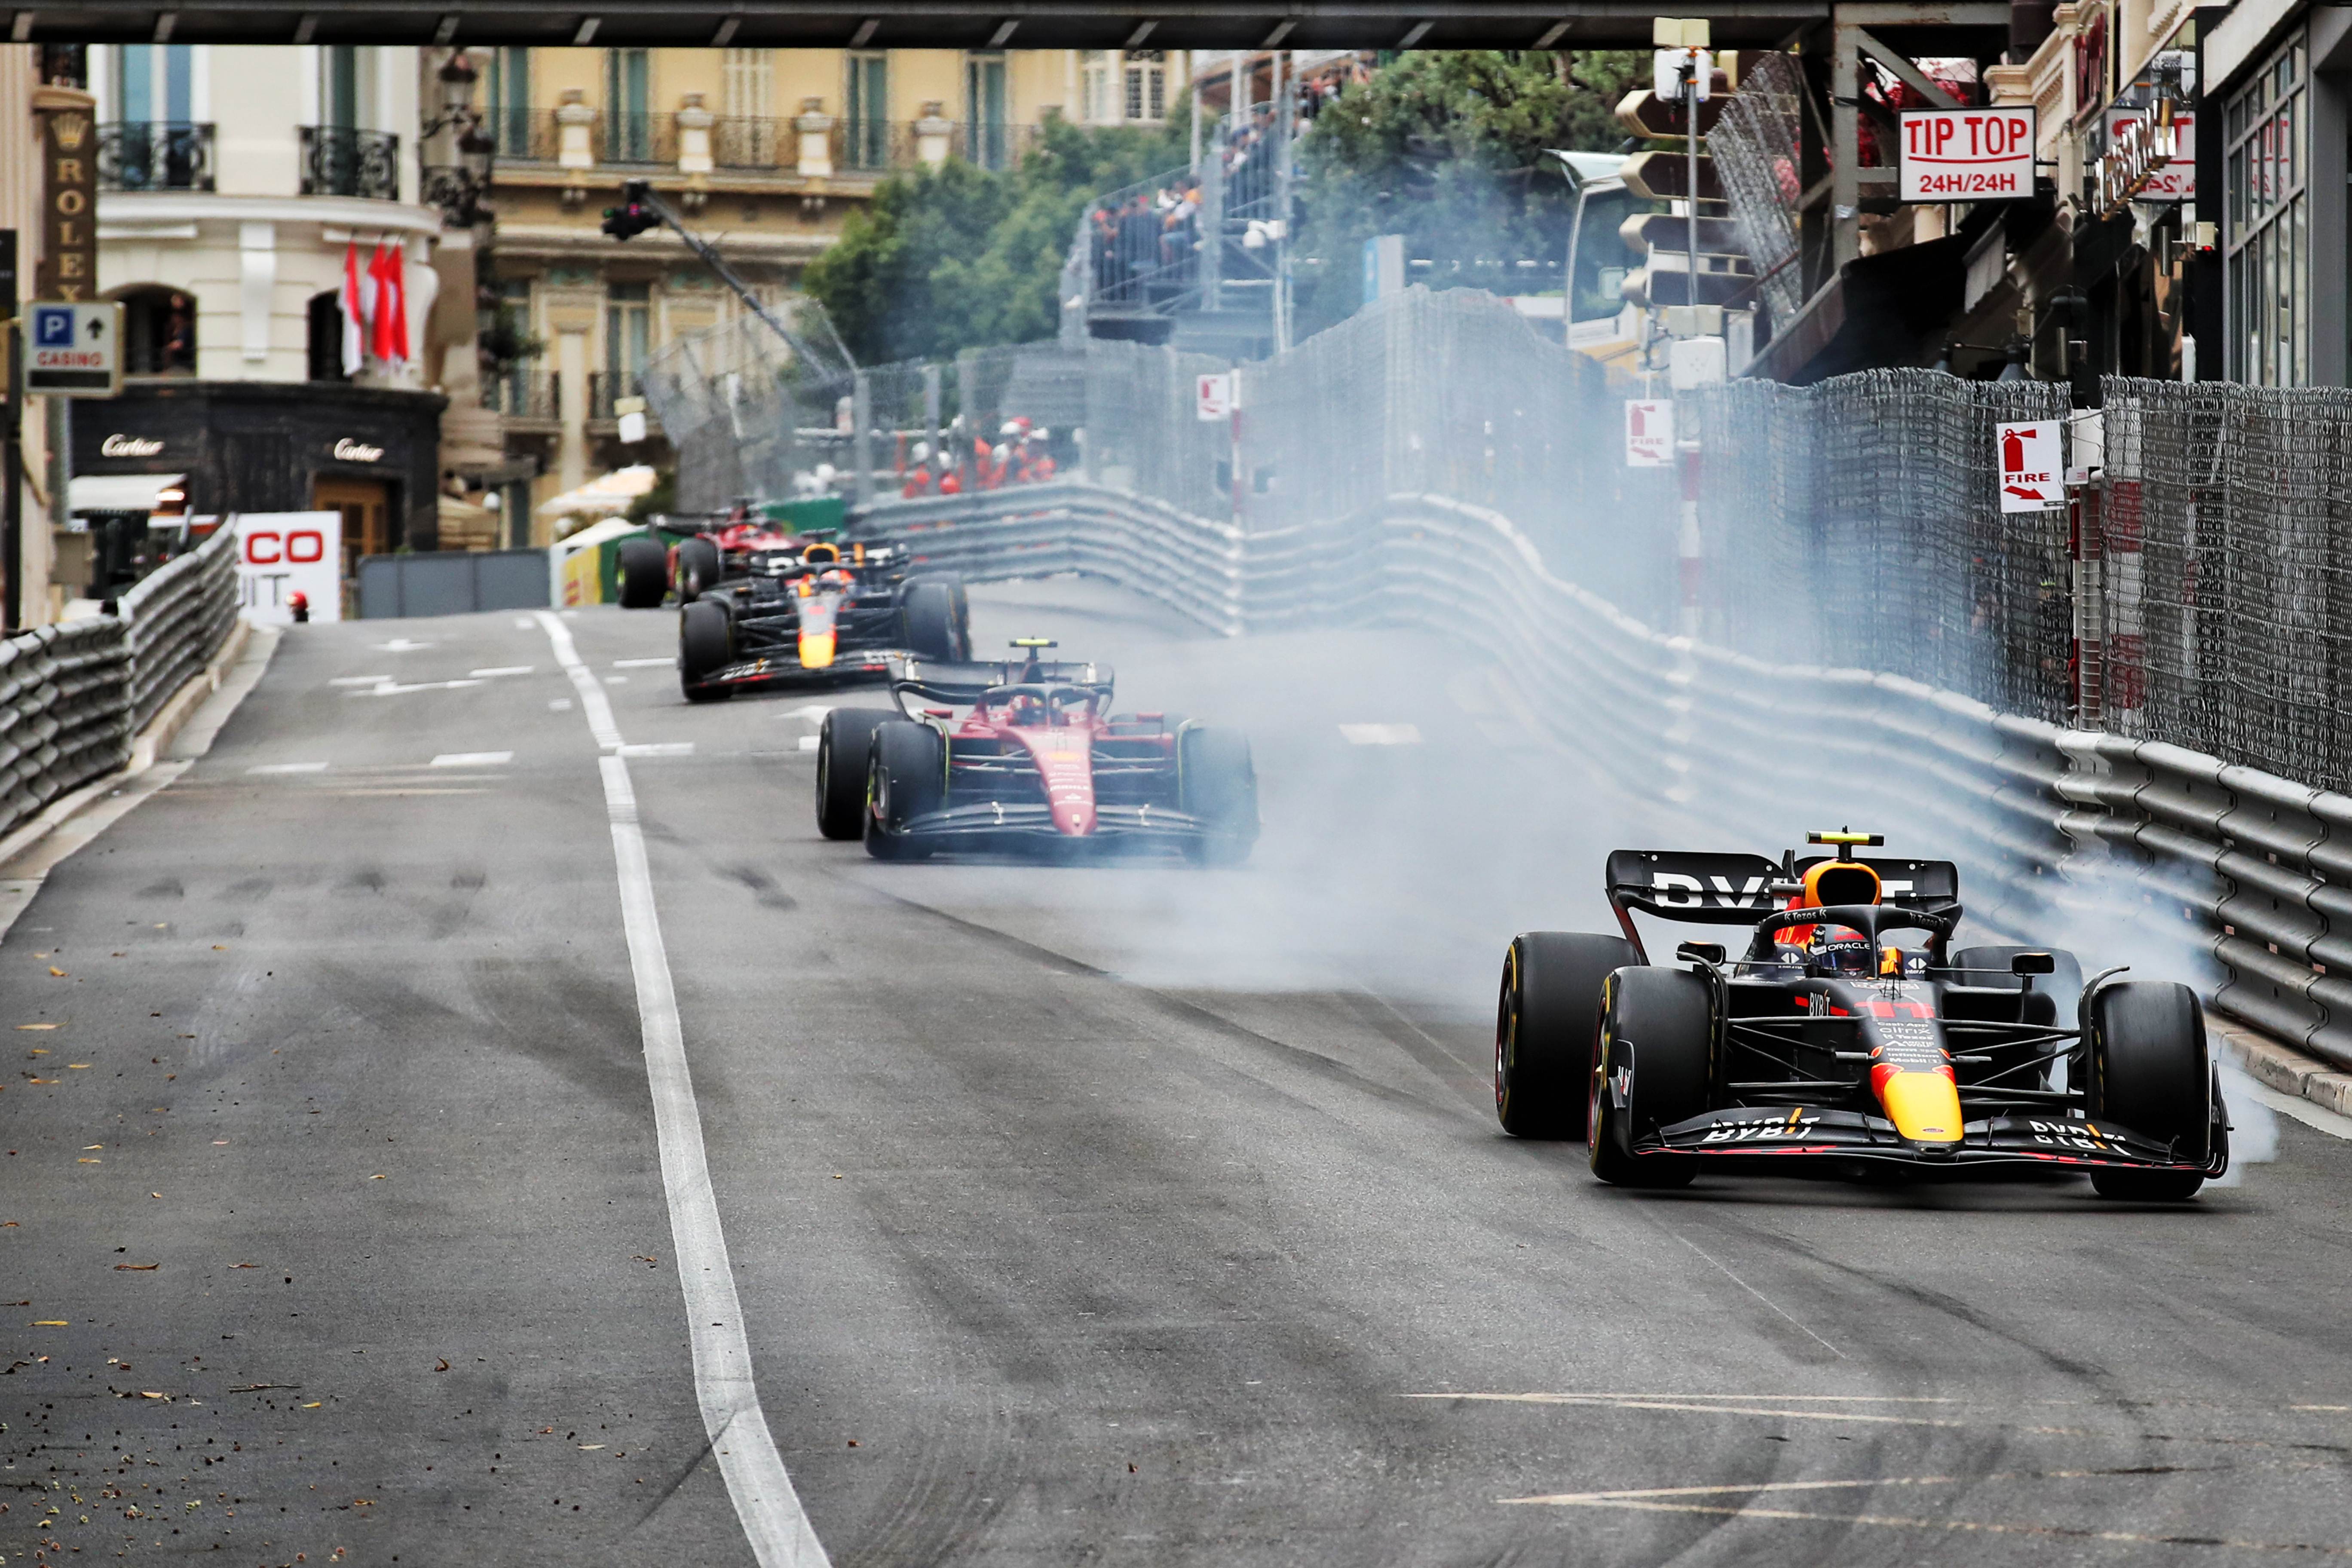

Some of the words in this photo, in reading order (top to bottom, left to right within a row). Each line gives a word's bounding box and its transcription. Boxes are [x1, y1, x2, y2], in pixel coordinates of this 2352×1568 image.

[1904, 118, 1954, 155] TIP
[1964, 116, 2027, 155] TOP
[1920, 173, 2015, 192] 24H/24H
[56, 158, 86, 302] ROLEX
[38, 352, 103, 366] CASINO
[101, 433, 165, 457] Cartier
[334, 438, 384, 462] Cartier
[2005, 473, 2050, 483] FIRE
[238, 531, 323, 564] CO
[1792, 912, 1816, 920] Tezos
[1917, 915, 1938, 927] Tezos
[1828, 942, 1870, 951] ORACLE
[1810, 989, 1830, 1016] BYBIT
[1853, 1001, 1935, 1018] 11
[1702, 1107, 1820, 1142] BYBIT
